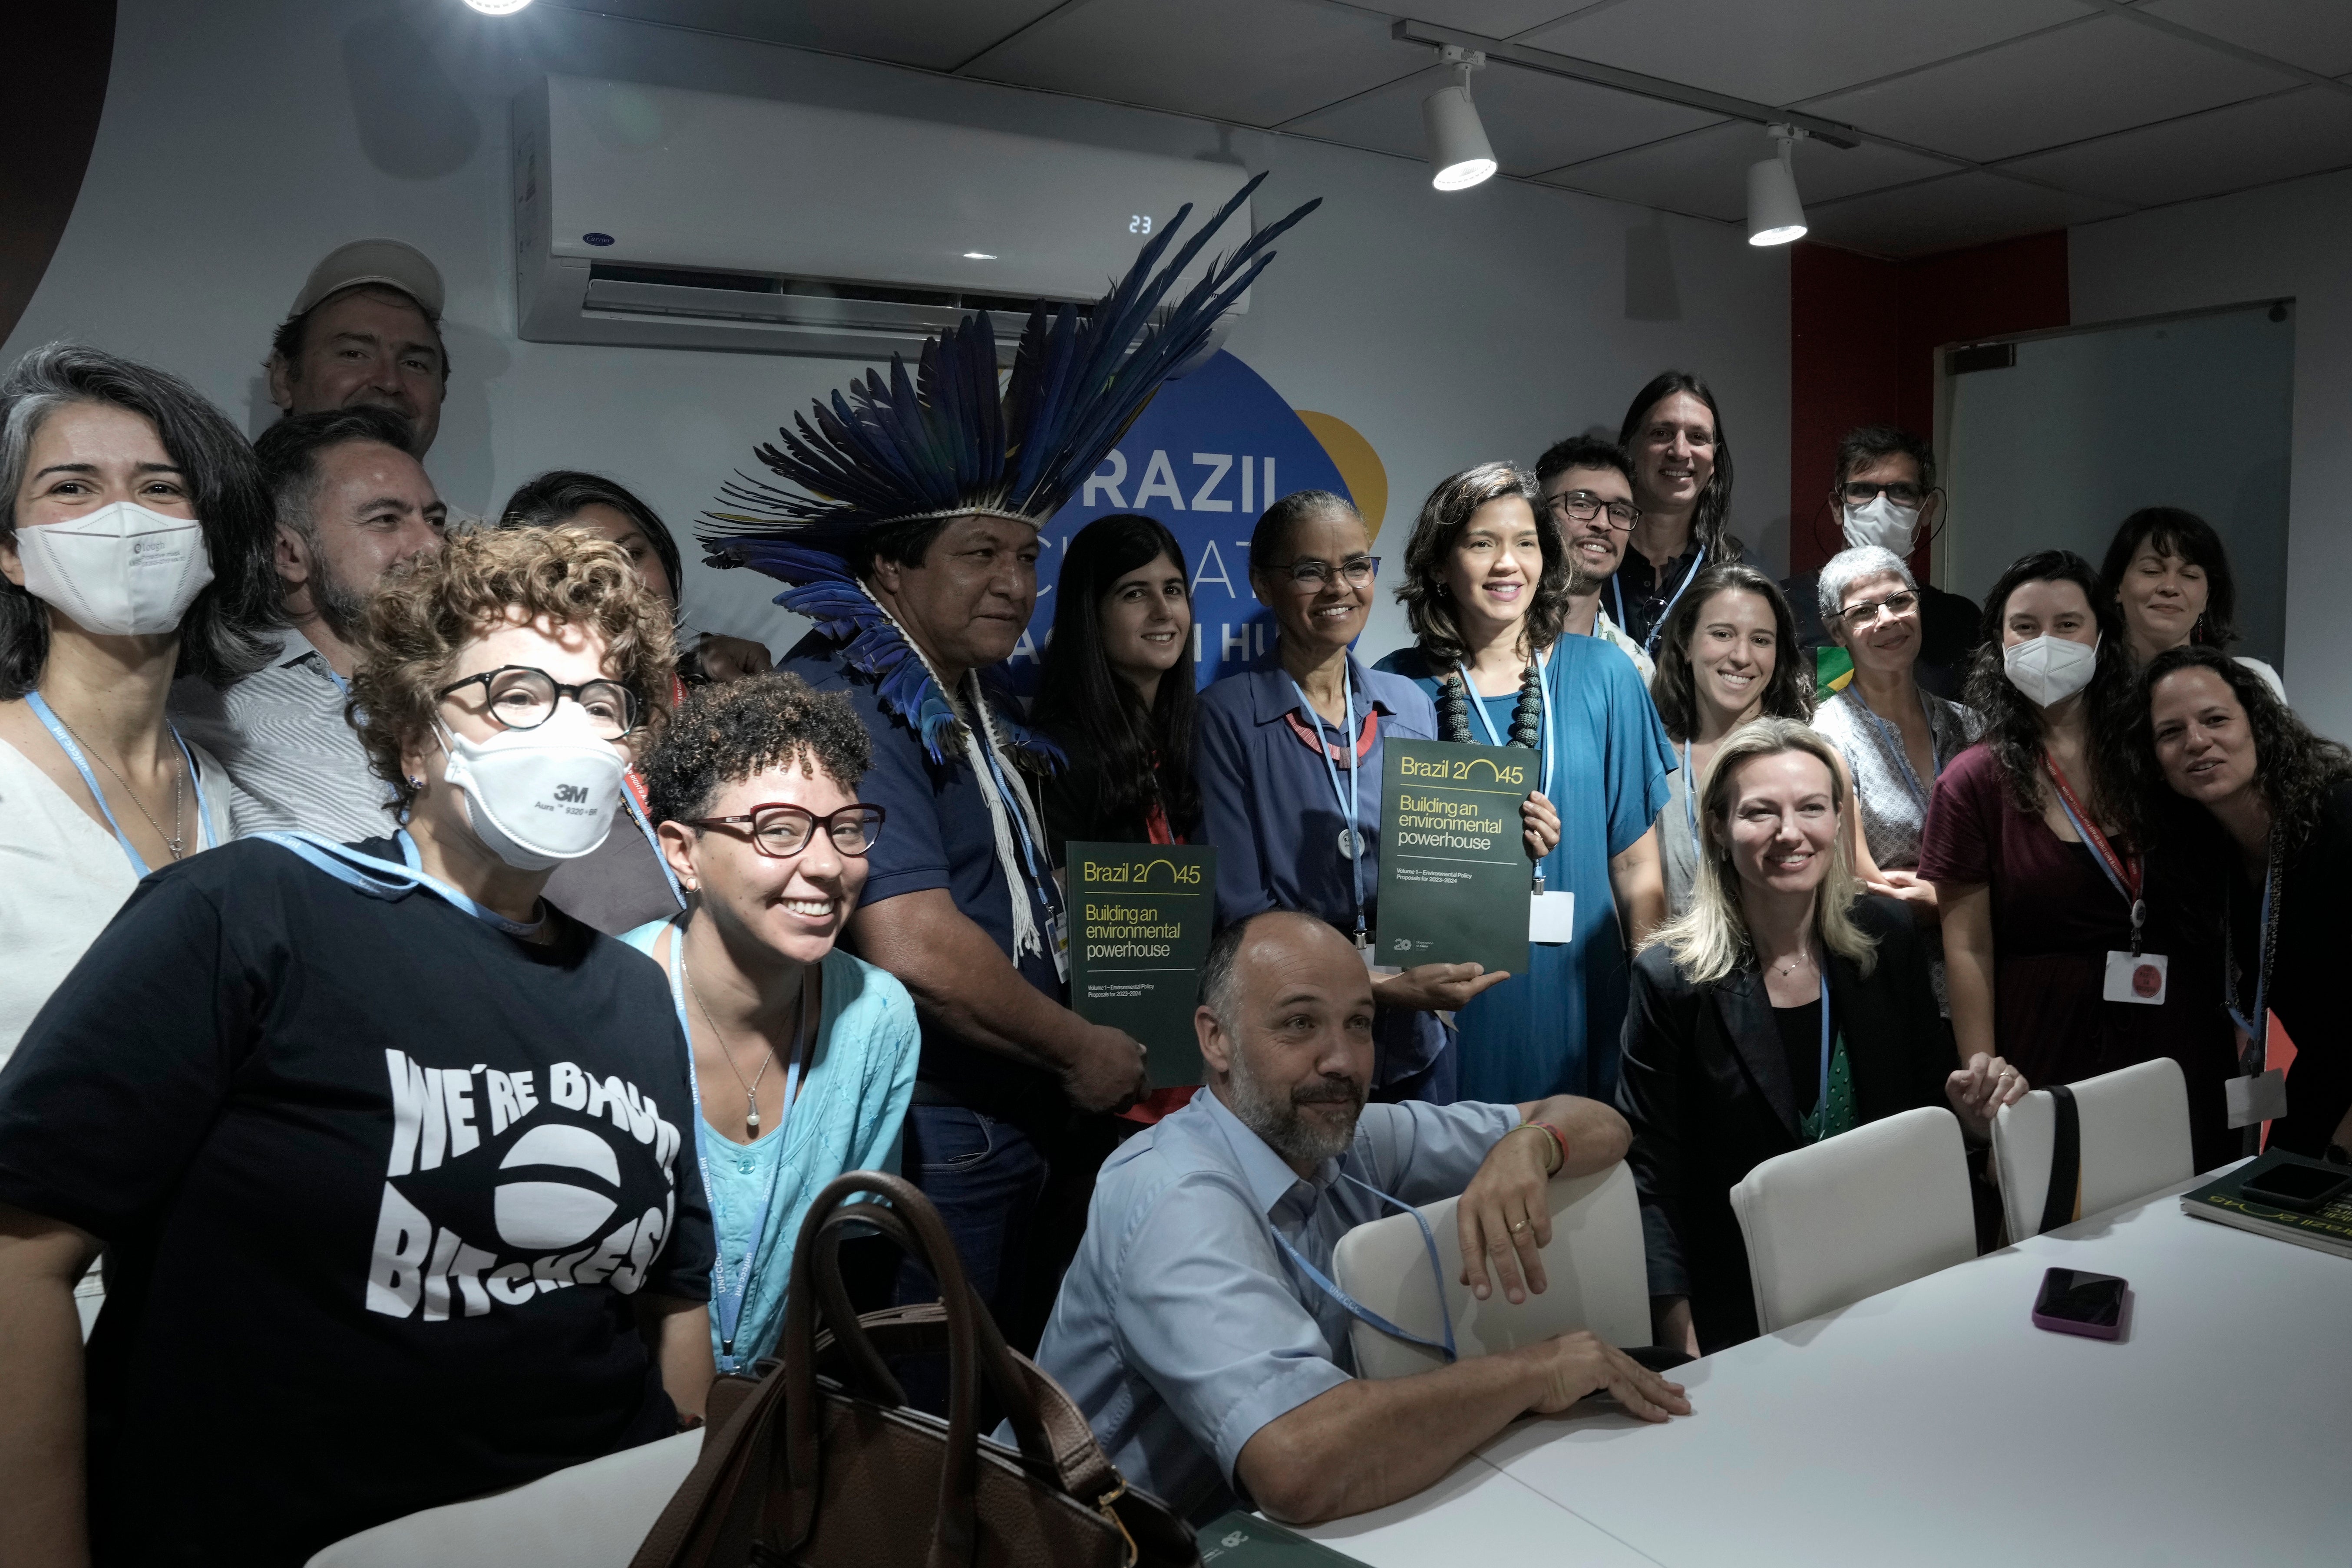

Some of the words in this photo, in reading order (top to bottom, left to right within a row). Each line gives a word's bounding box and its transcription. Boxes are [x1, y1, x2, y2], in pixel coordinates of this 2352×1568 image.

[1129, 215, 1152, 234] 23
[586, 235, 612, 244] Carrier
[1401, 756, 1449, 779] Brazil
[553, 784, 589, 804] 3M
[629, 774, 644, 795] RIGHTS
[535, 802, 554, 812] Aura
[1400, 795, 1458, 818] Building
[1460, 803, 1478, 816] an
[1398, 815, 1502, 835] environmental
[1398, 831, 1491, 850] powerhouse
[1084, 862, 1129, 882] Brazil
[1086, 904, 1139, 924] Building
[1140, 909, 1157, 921] an
[1086, 922, 1181, 939] environmental
[1087, 941, 1170, 961] powerhouse
[699, 1156, 714, 1203] unfccc.int
[1329, 1284, 1362, 1314] UNFCCC
